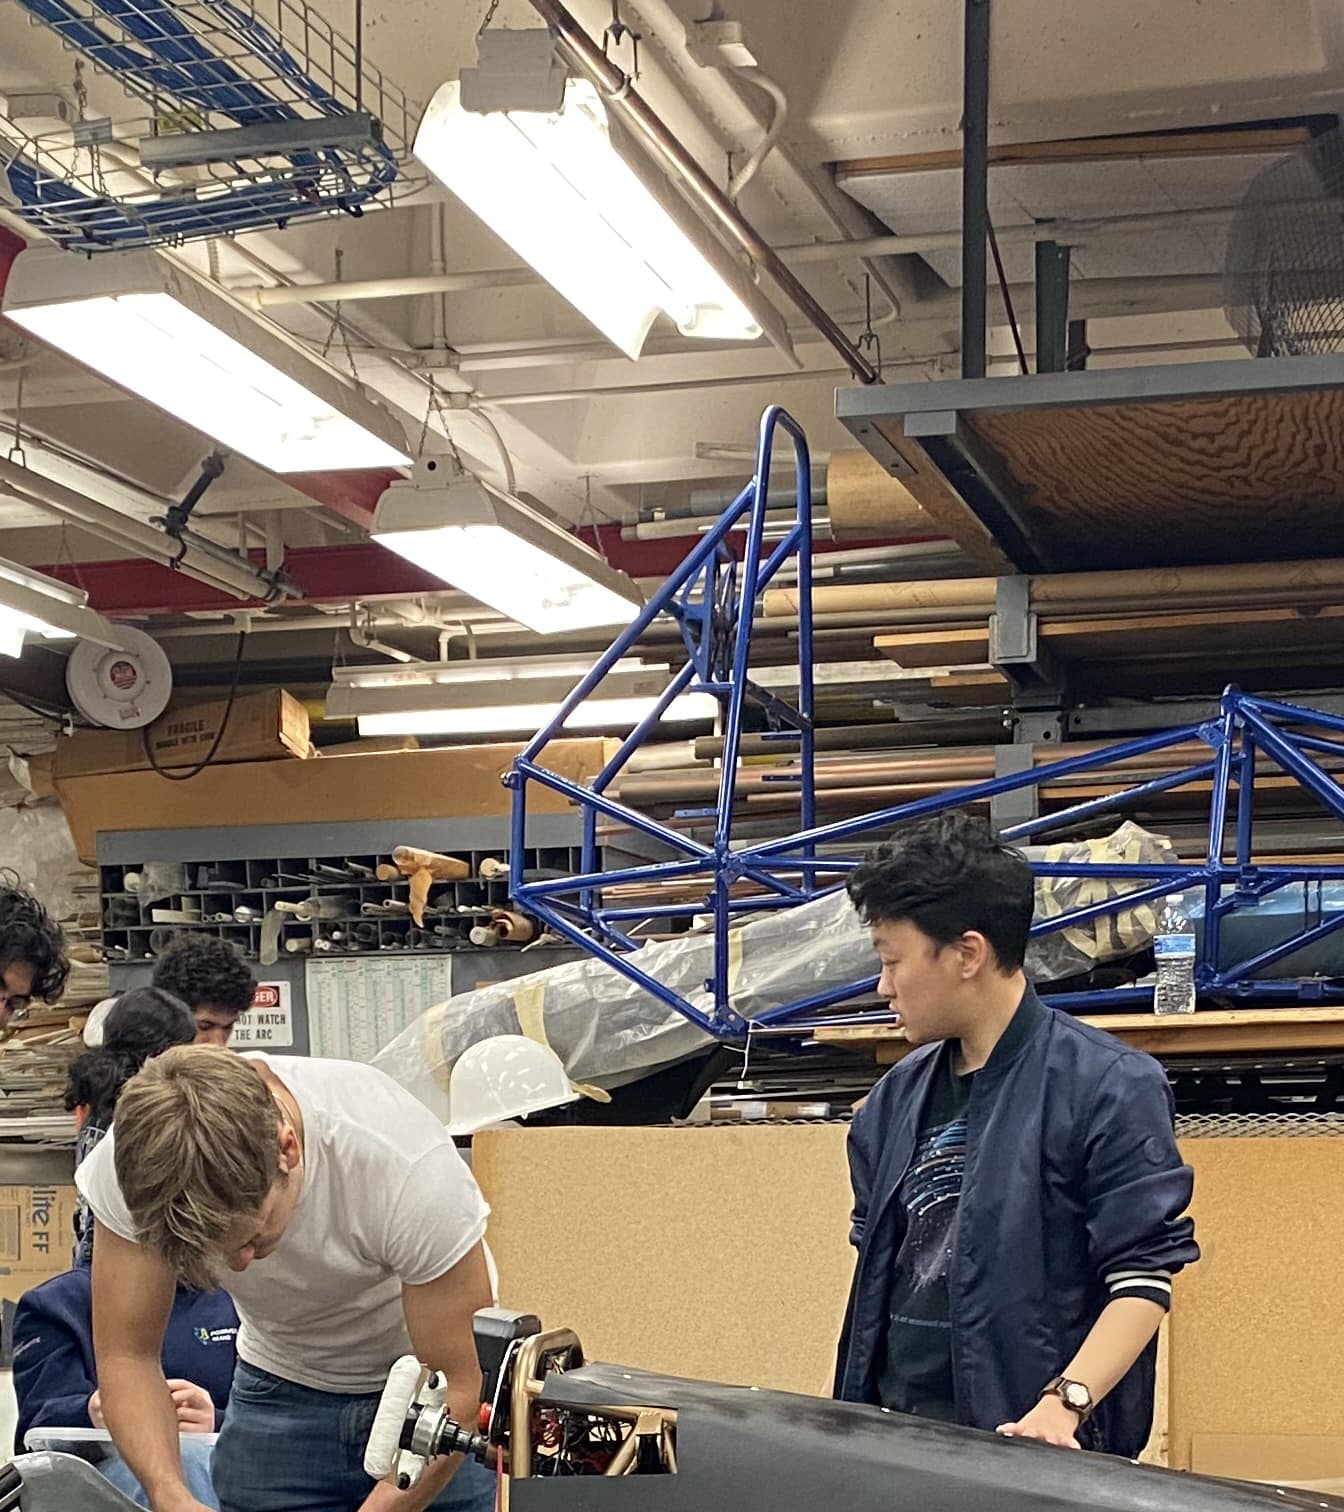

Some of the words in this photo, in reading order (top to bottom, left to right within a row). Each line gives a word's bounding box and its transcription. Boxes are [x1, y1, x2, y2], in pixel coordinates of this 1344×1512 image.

[258, 1013, 286, 1025] WATCH
[235, 1029, 252, 1041] THE
[256, 1029, 273, 1040] ARC
[32, 1232, 50, 1254] FF
